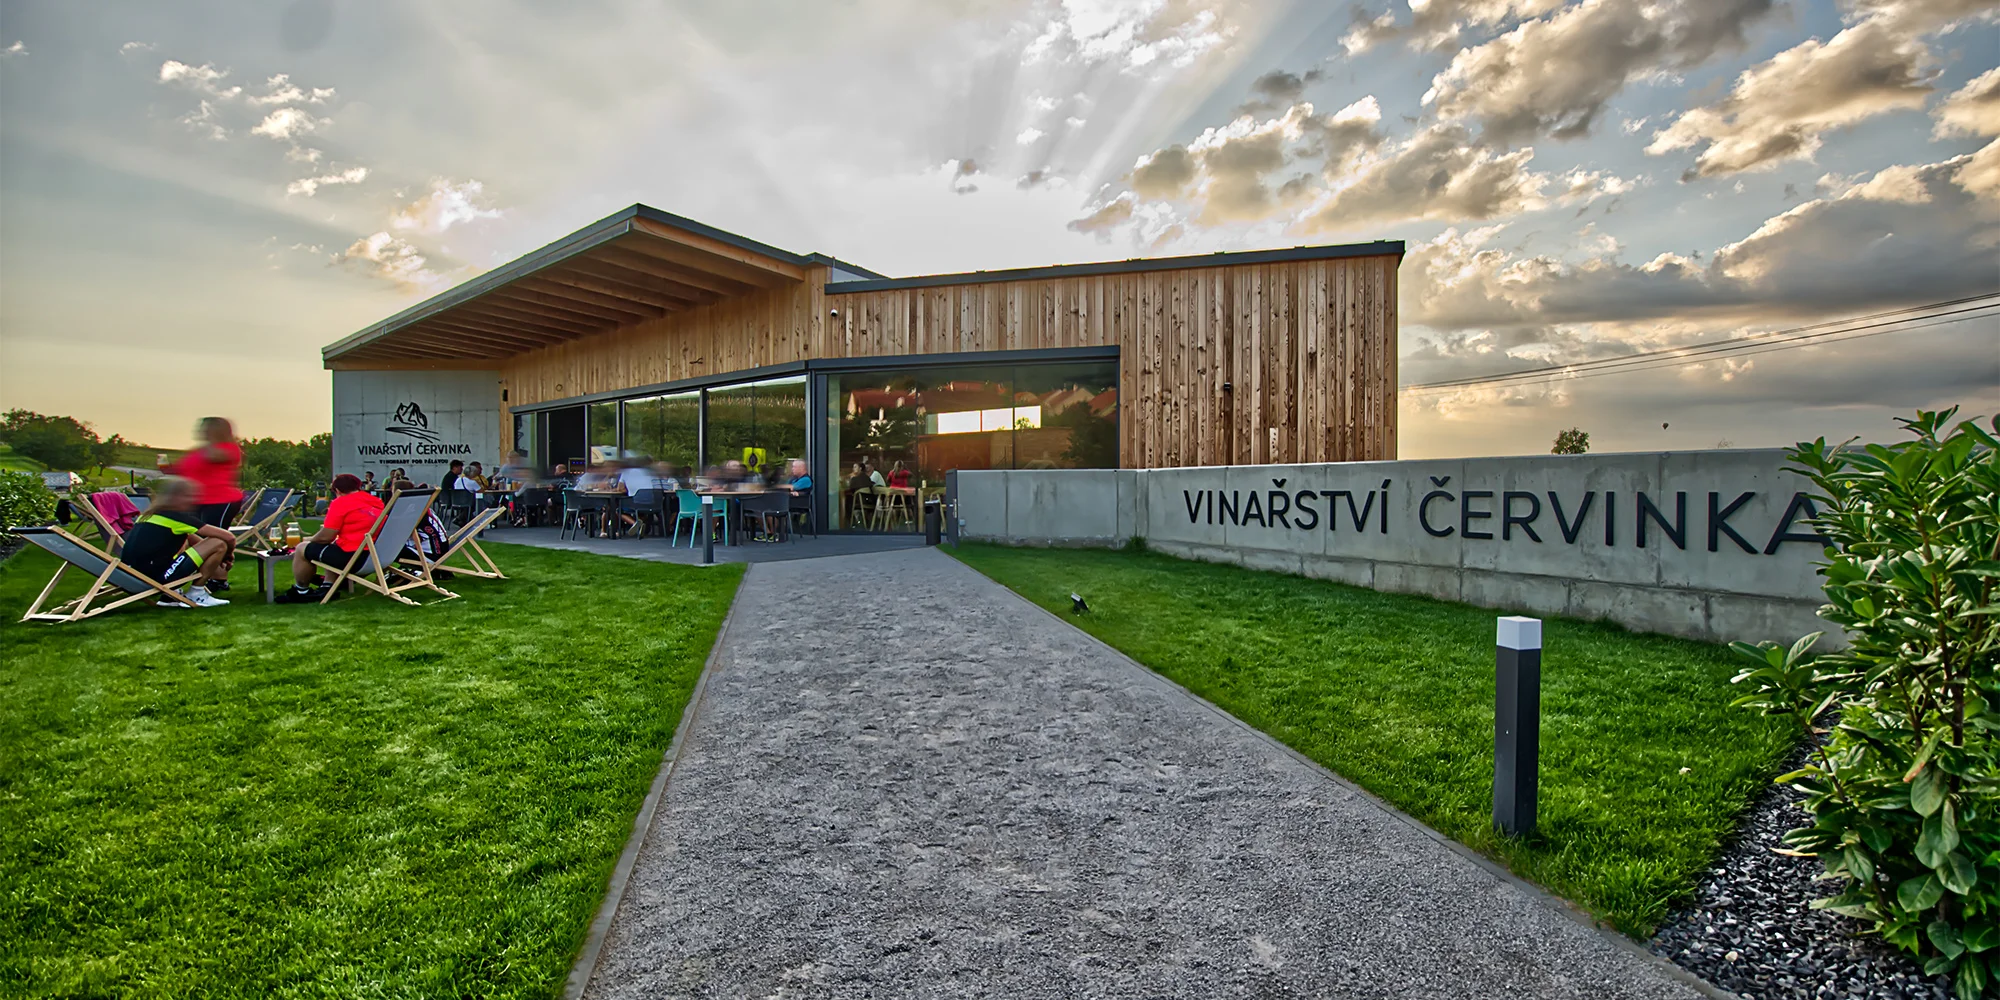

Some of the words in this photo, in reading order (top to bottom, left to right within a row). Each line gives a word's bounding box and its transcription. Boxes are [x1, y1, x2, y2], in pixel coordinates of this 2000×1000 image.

[357, 442, 412, 456] VINAŘSTVÍ
[416, 442, 472, 455] ČERVINKA
[1183, 478, 1391, 535] VINAŘSTVÍ
[1419, 476, 1838, 556] ČERVINKA
